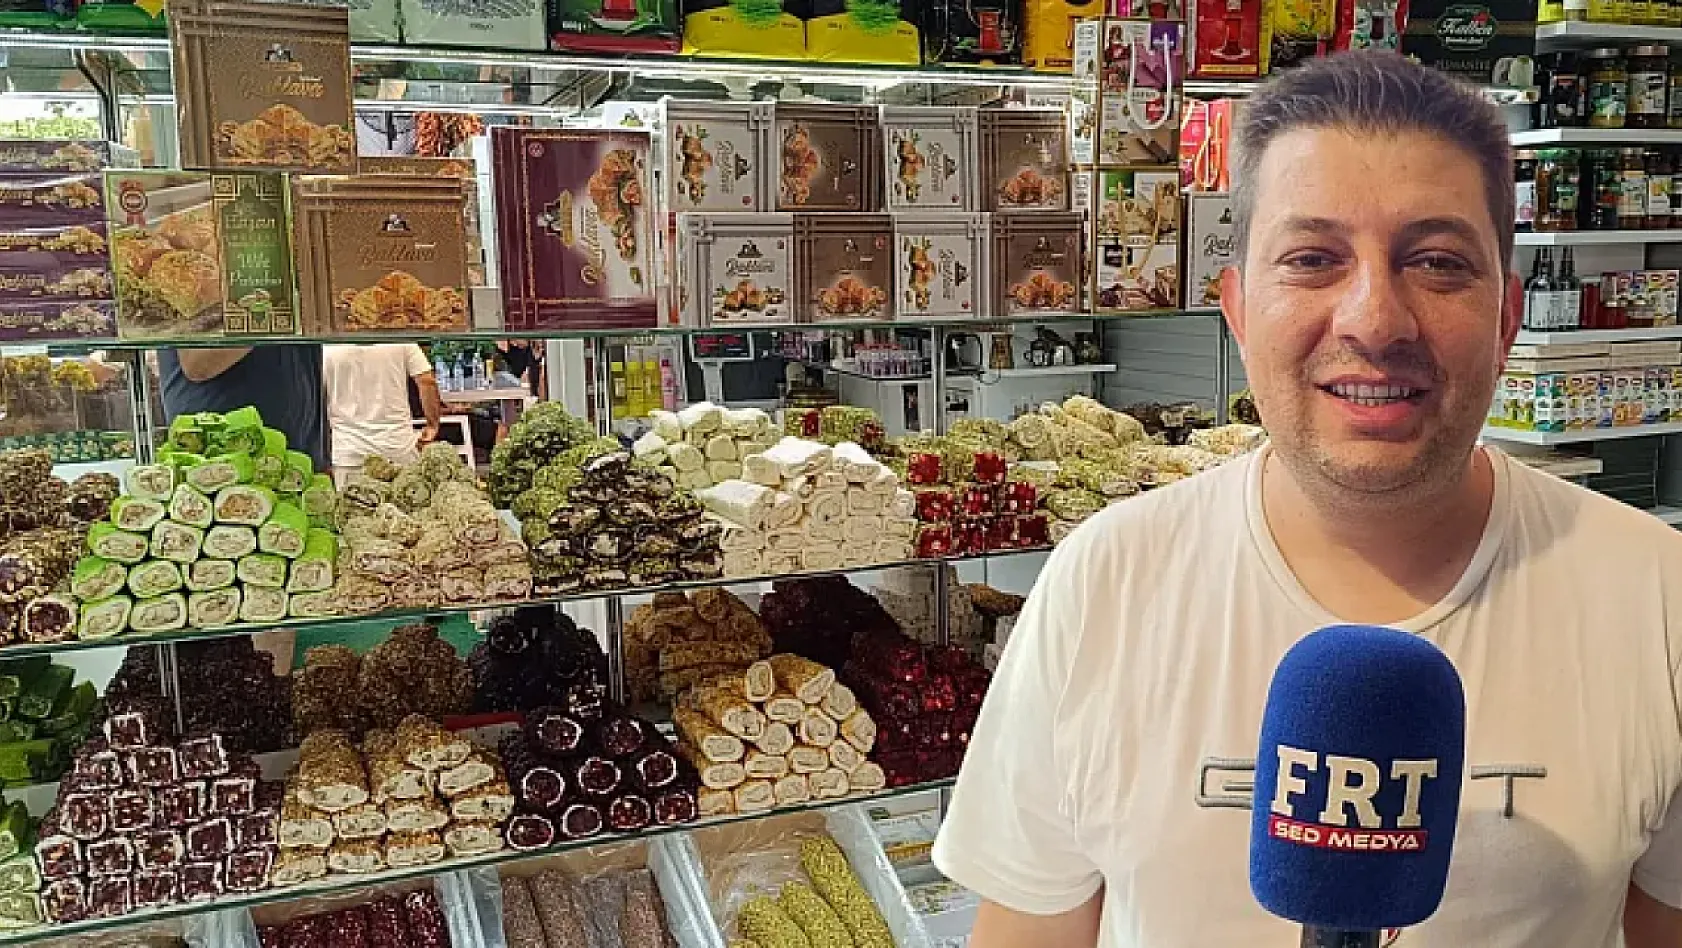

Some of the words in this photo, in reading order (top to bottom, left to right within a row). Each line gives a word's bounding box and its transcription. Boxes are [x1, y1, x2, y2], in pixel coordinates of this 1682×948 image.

[1270, 744, 1438, 829] FRT
[1274, 821, 1320, 844] SED
[1327, 831, 1420, 850] MEDYA
